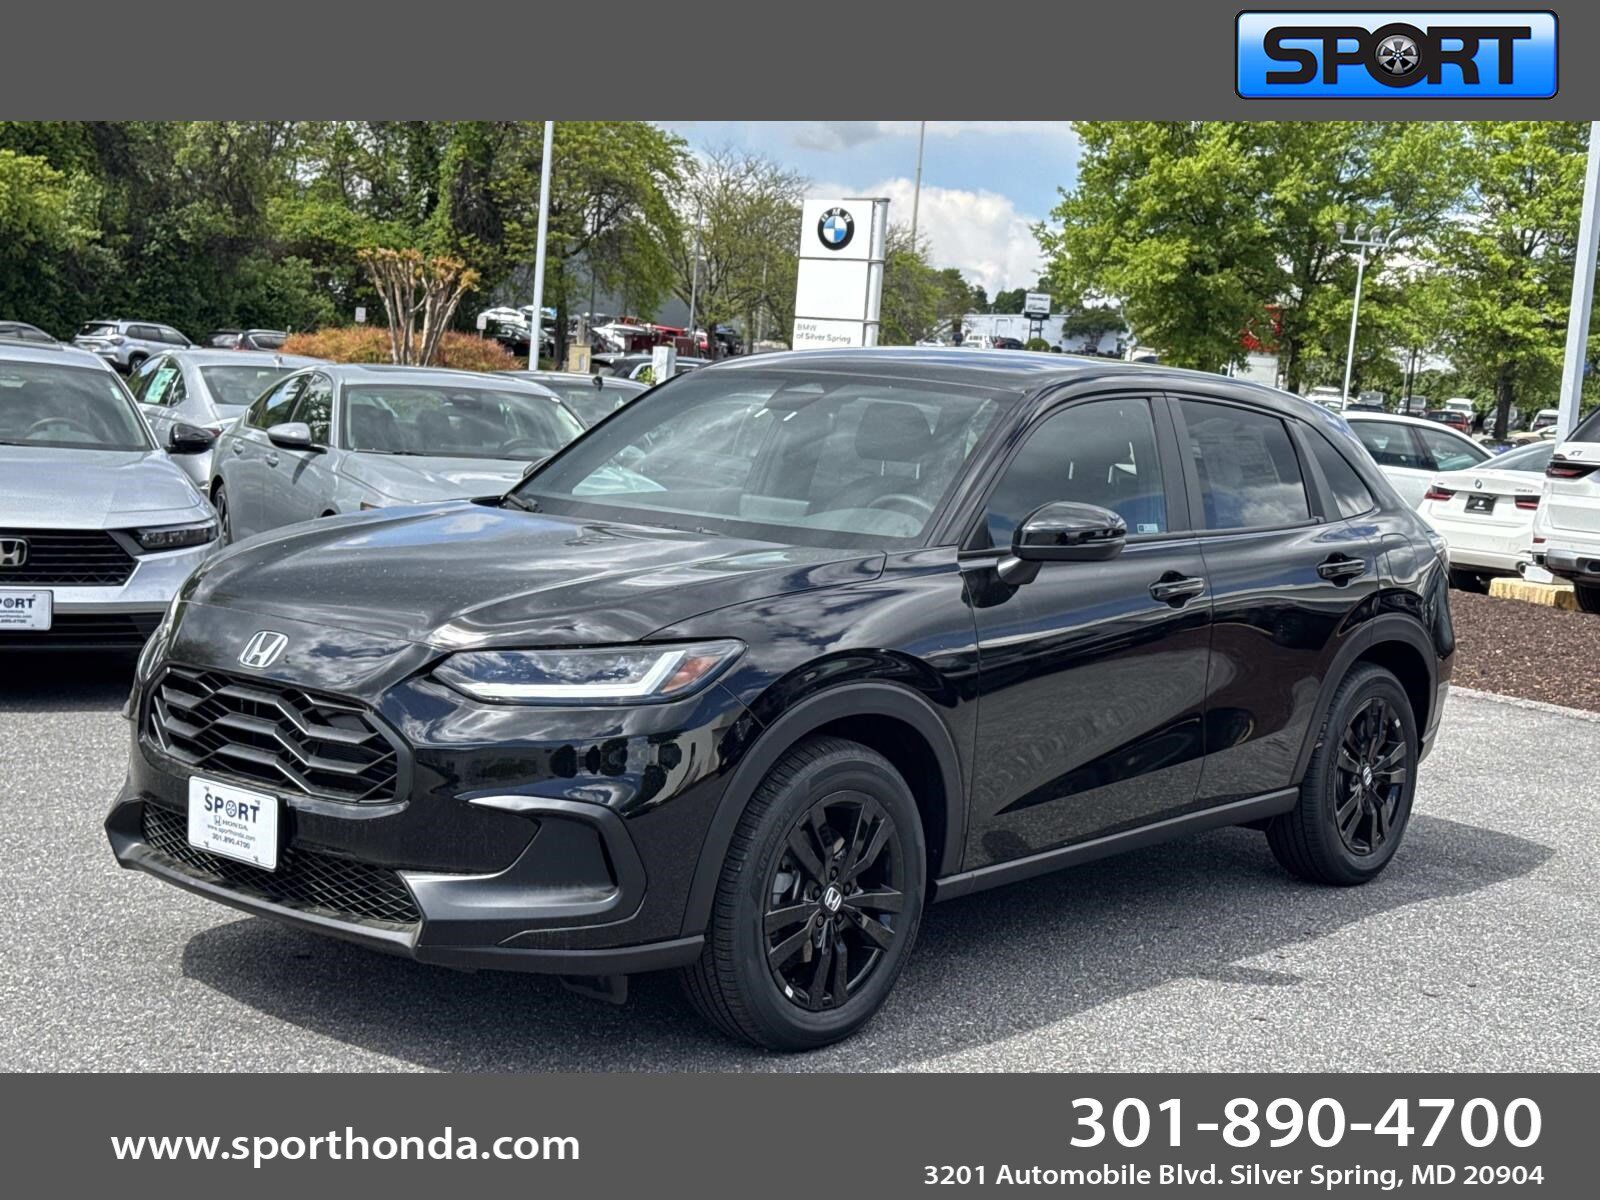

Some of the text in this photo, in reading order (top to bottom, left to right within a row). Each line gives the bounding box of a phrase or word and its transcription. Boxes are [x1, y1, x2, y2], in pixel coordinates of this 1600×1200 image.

[821, 208, 852, 223] BMW
[805, 333, 825, 341] Silver
[827, 334, 851, 344] Spring
[0, 597, 36, 609] ORT
[204, 792, 260, 824] SPORT
